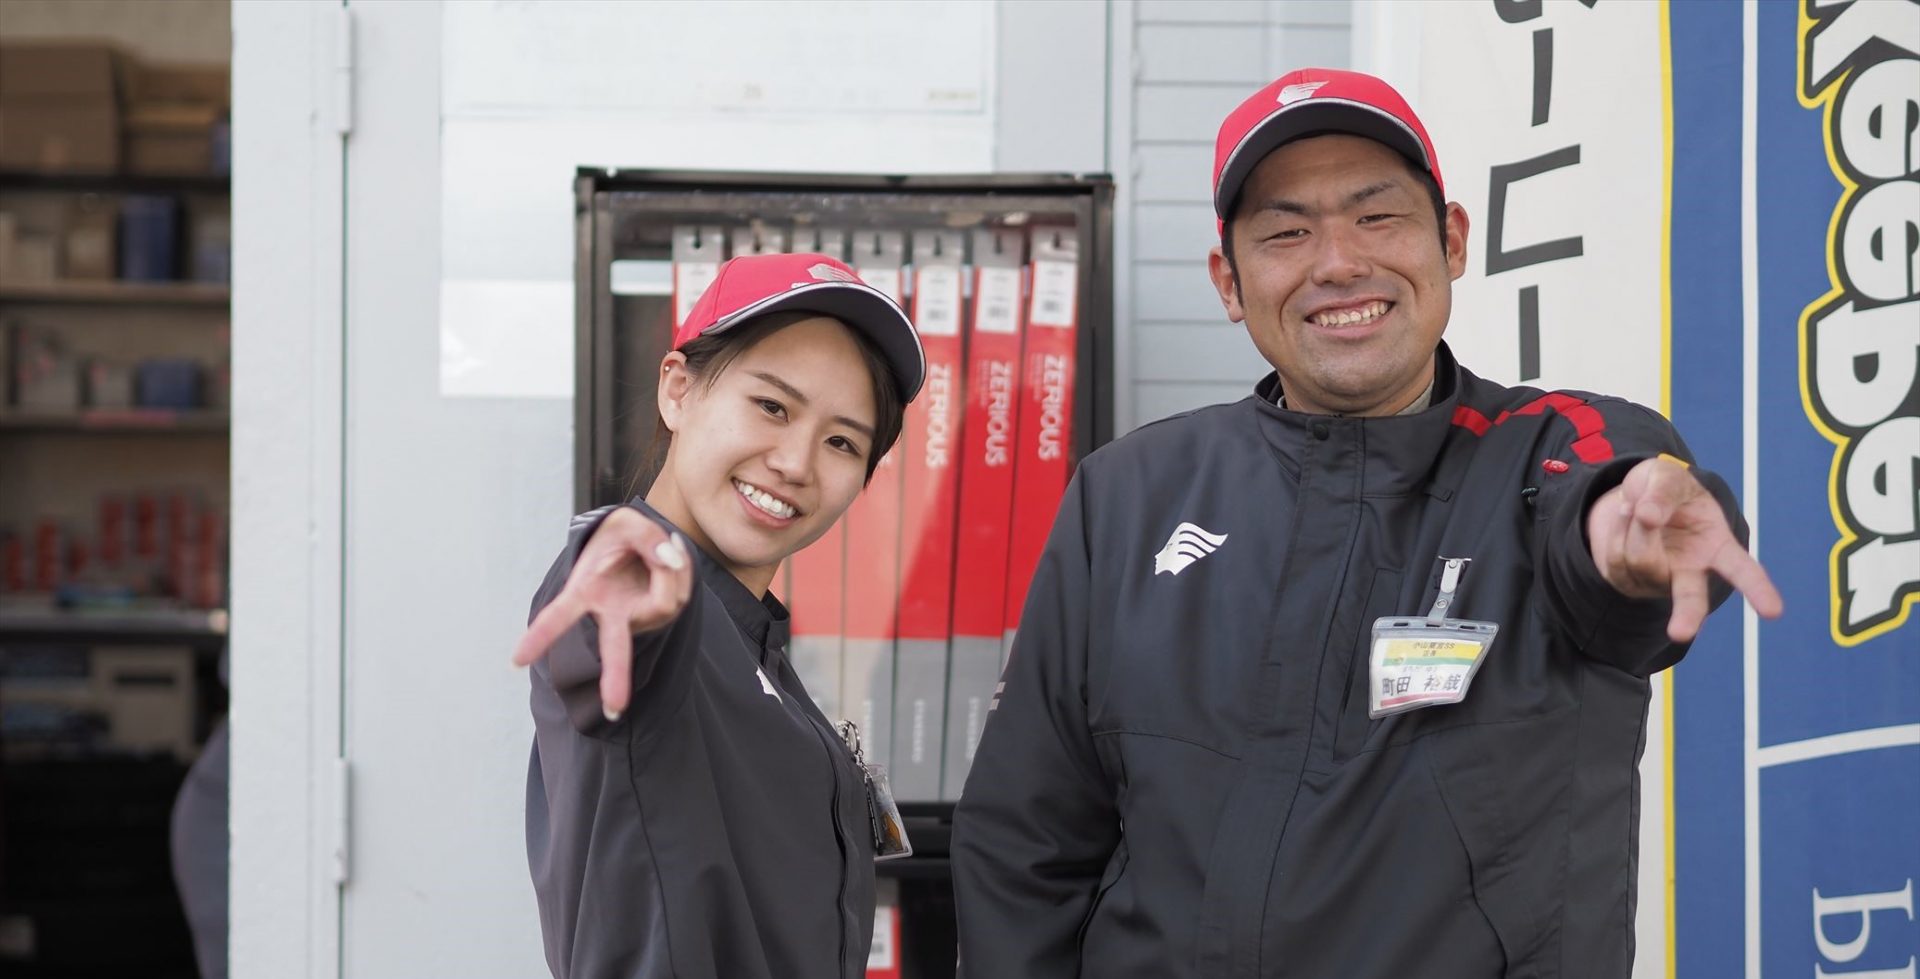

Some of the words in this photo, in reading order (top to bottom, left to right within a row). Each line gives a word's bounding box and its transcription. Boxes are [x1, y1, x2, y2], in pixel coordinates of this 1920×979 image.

[926, 362, 951, 469] ZERIOUS
[984, 360, 1013, 467] ZERIOUS
[1038, 353, 1067, 461] ZERIOUS
[1382, 676, 1411, 696] 町田
